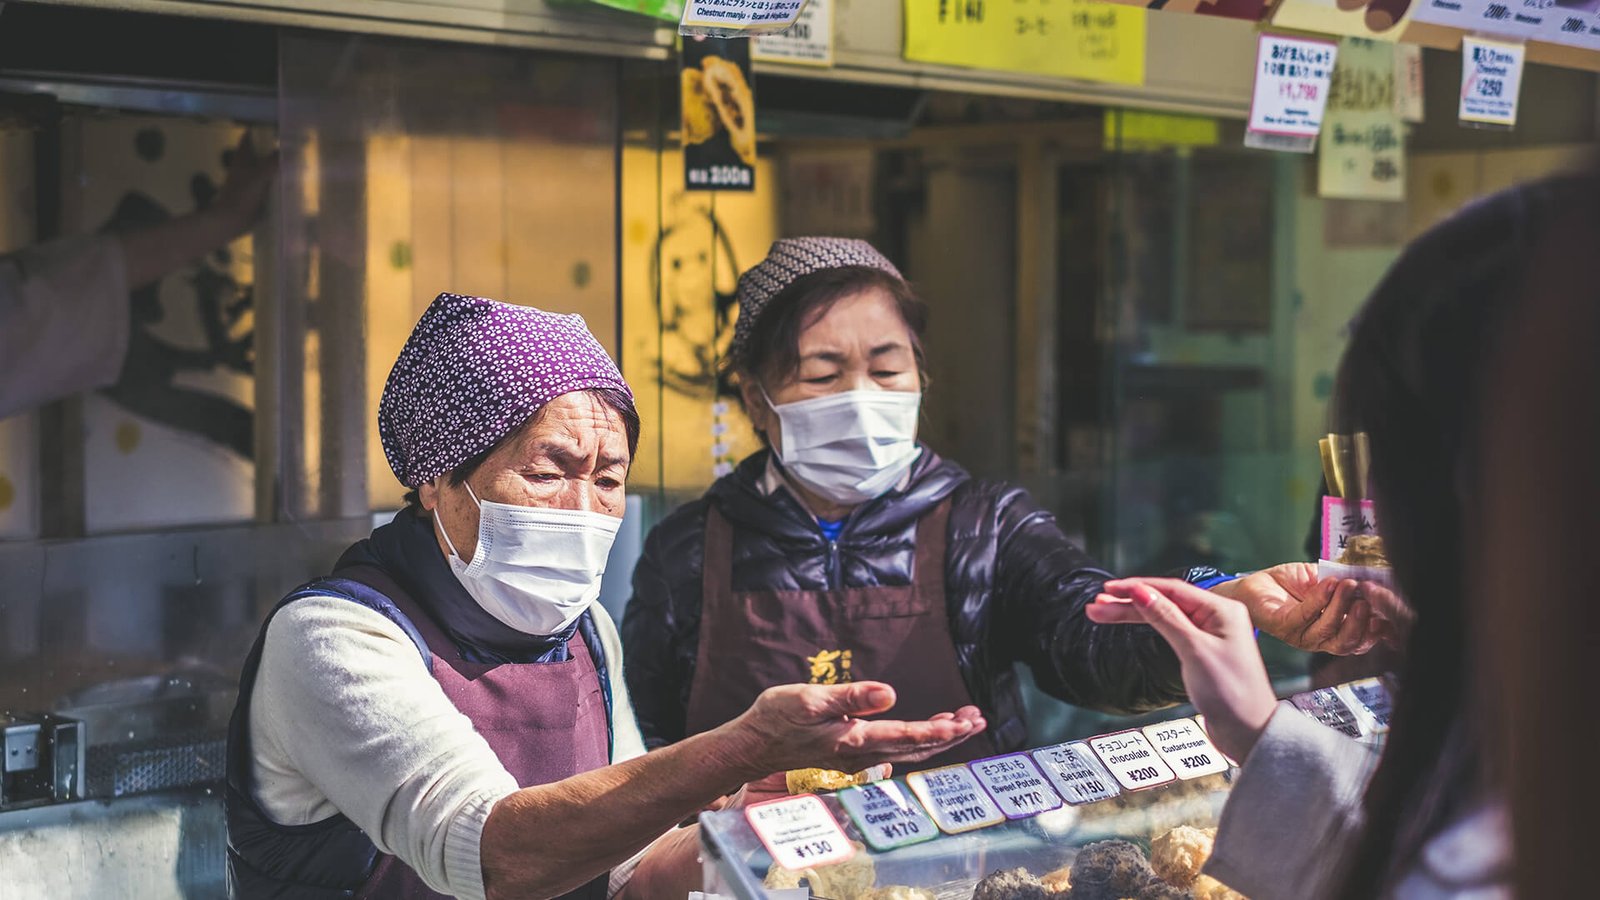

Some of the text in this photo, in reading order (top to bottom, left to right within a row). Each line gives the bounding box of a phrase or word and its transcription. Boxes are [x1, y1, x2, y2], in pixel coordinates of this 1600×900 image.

[696, 8, 727, 18] Chestnut
[727, 11, 746, 20] manju
[1156, 725, 1193, 742] カスタード
[1097, 736, 1143, 754] チョコレート
[1162, 738, 1206, 754] Custard cream
[1050, 748, 1078, 764] ごま
[1109, 749, 1150, 765] chocolate
[1180, 753, 1211, 769] ¥200
[981, 758, 1026, 775] さつまいも
[1127, 766, 1159, 782] ¥200
[991, 781, 1015, 794] Sweet
[1071, 780, 1105, 798] ¥150
[1008, 791, 1043, 808] ¥170
[865, 807, 916, 824] Green Tea
[950, 805, 987, 824] ¥170
[881, 821, 919, 838] ¥170
[794, 840, 833, 858] ¥130
